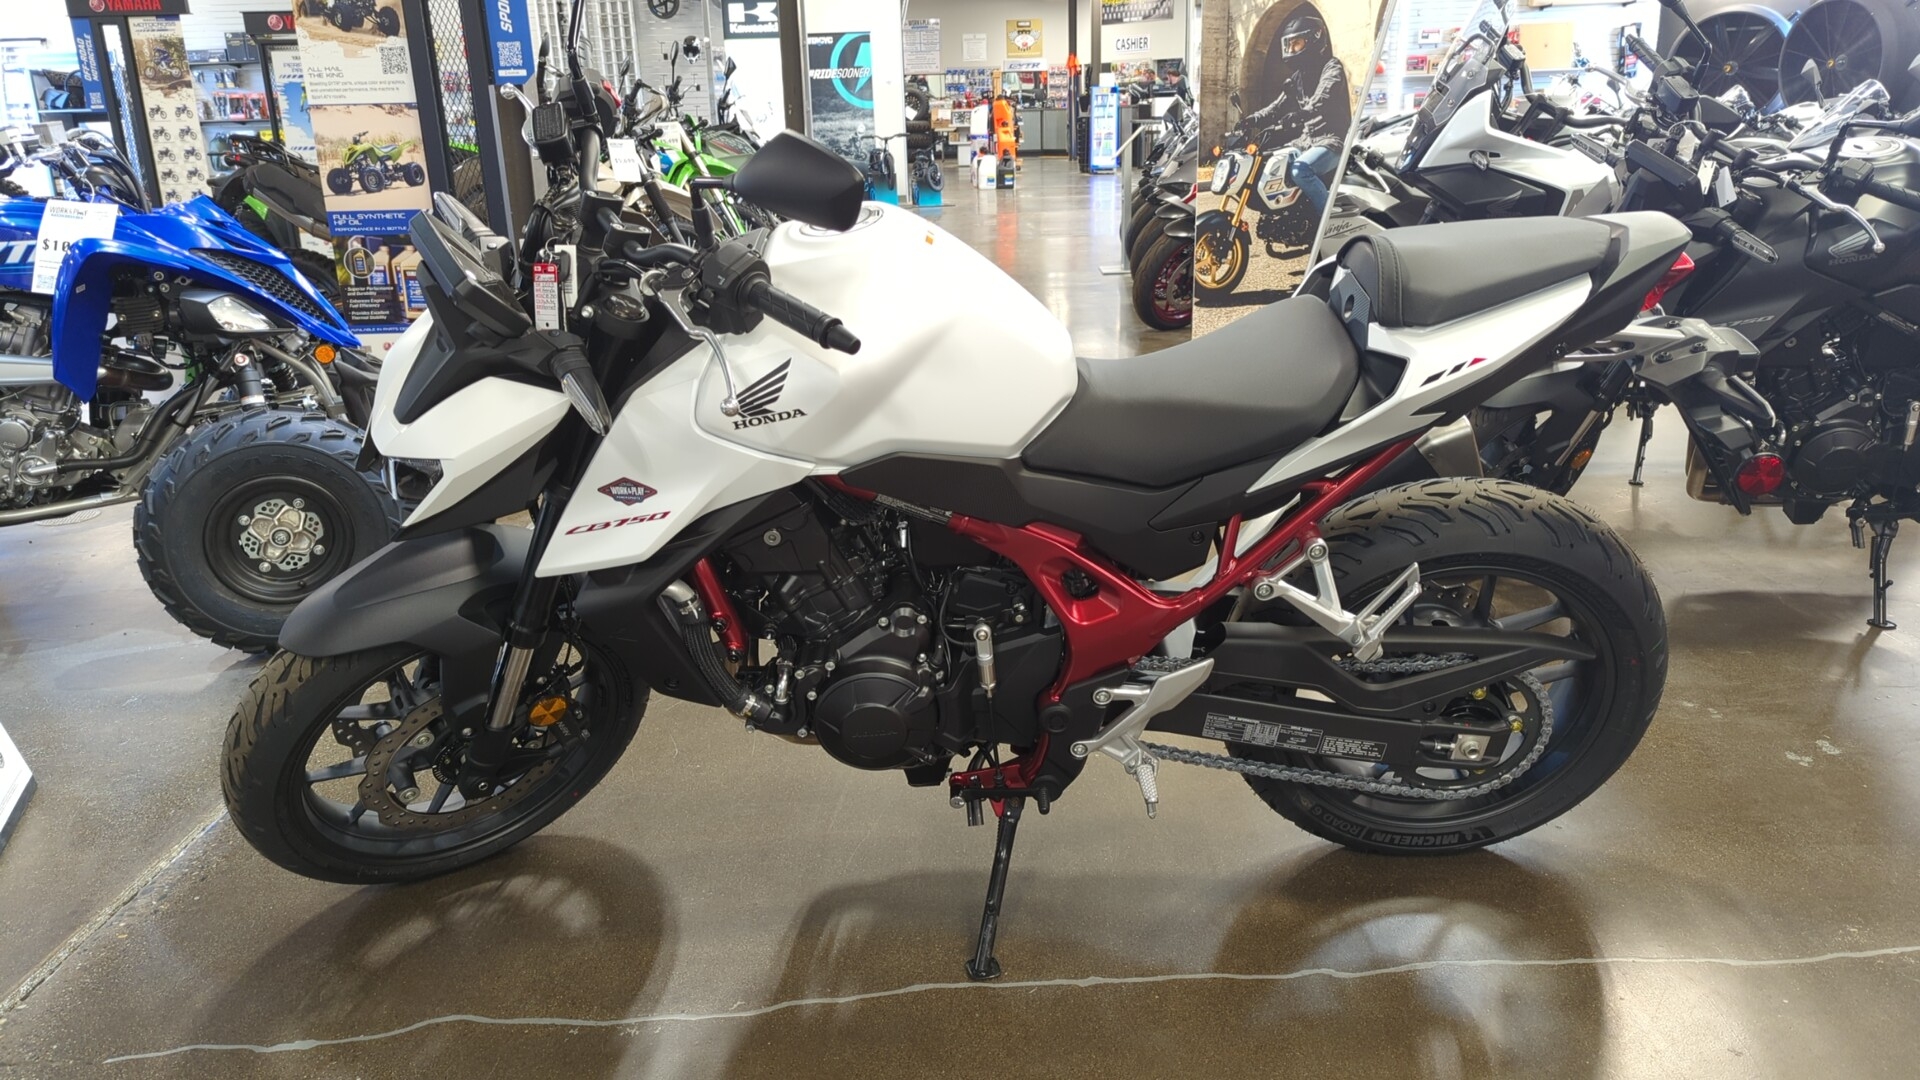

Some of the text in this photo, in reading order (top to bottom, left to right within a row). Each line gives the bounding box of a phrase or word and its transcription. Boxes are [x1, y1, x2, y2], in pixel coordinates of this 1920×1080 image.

[107, 0, 162, 11] YAMAHA
[729, 22, 778, 34] Kawasaki
[1116, 37, 1148, 50] CASHIER
[77, 37, 92, 82] OFF-ROAD
[84, 33, 99, 82] MOTORCYCLE
[1828, 253, 1878, 266] HONDA
[732, 408, 807, 430] HONDA
[565, 511, 671, 535] CB750
[1312, 807, 1459, 846] MICHELIN ROAD 6
